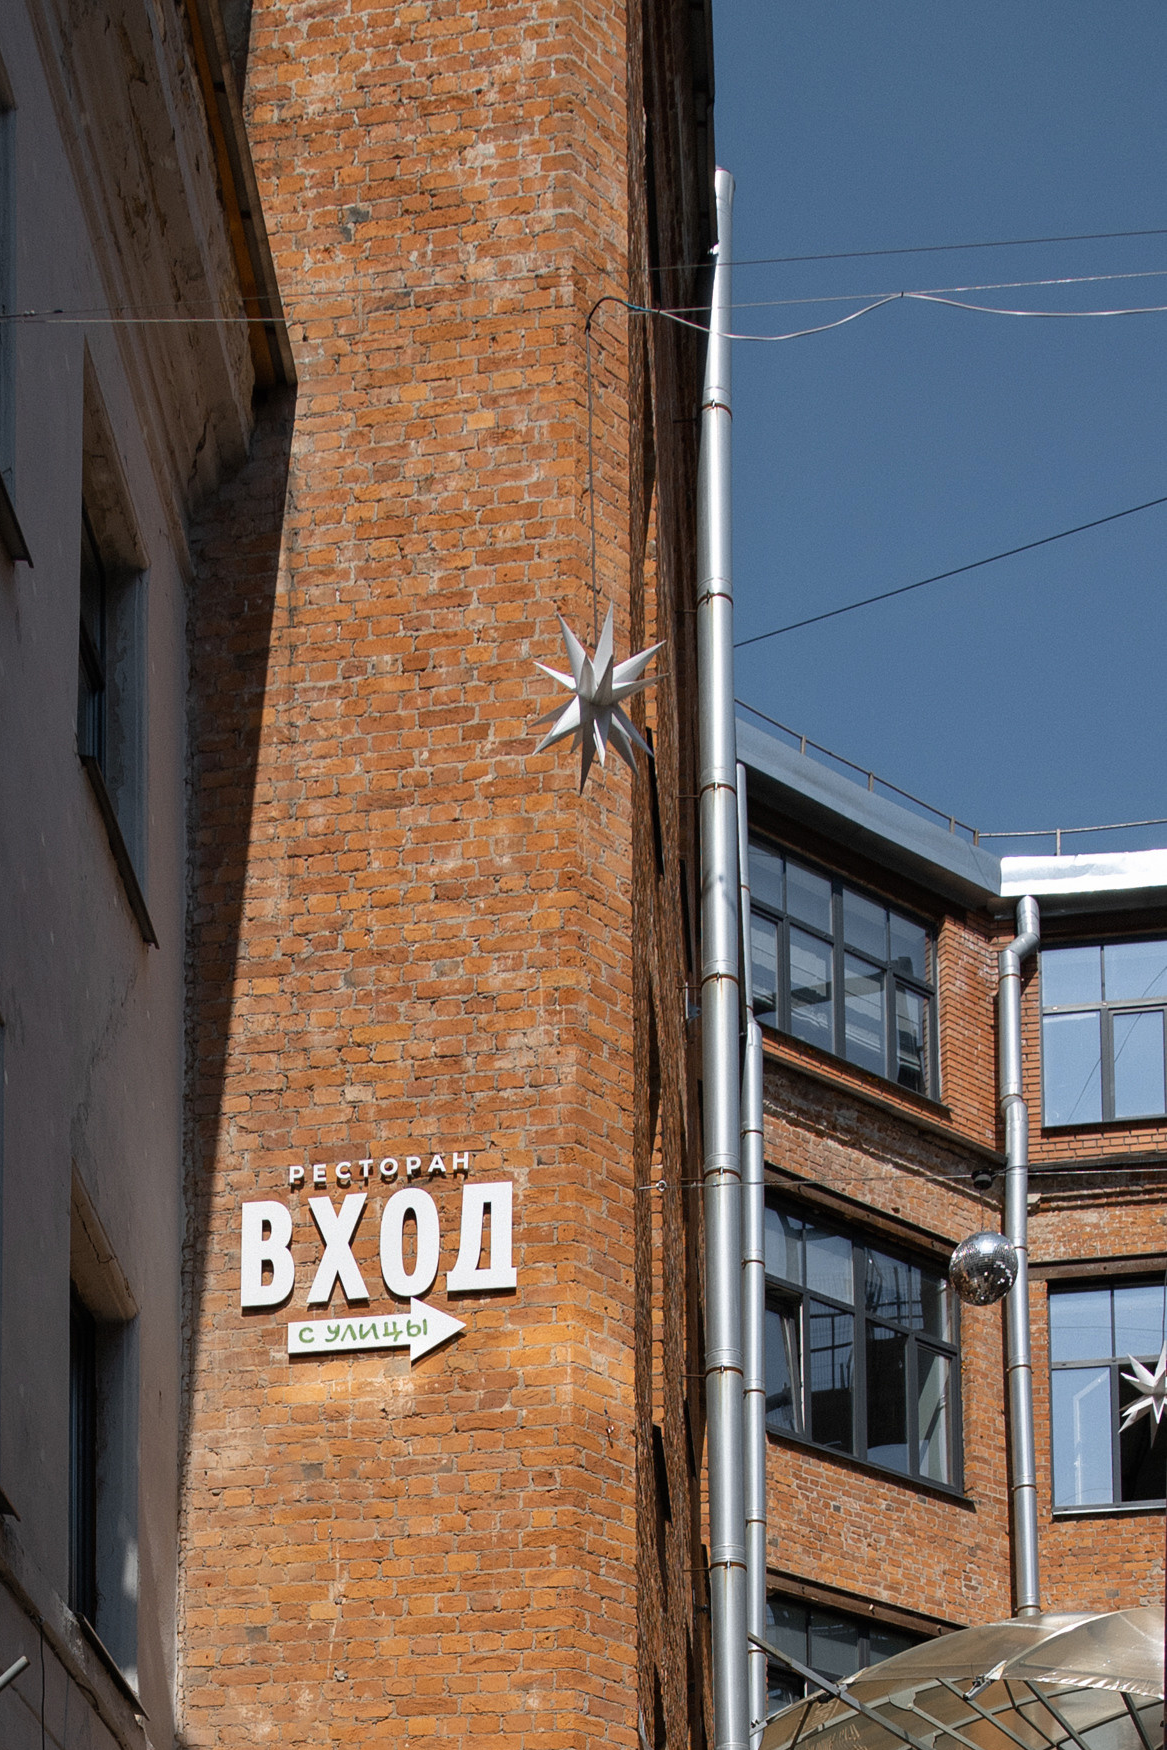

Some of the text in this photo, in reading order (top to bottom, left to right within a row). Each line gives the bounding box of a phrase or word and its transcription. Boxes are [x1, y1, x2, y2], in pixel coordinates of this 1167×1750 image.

[289, 1151, 470, 1184] РЕСТОРАН
[240, 1181, 517, 1308] ВХОД
[324, 1318, 429, 1343] УЛИЦЫ
